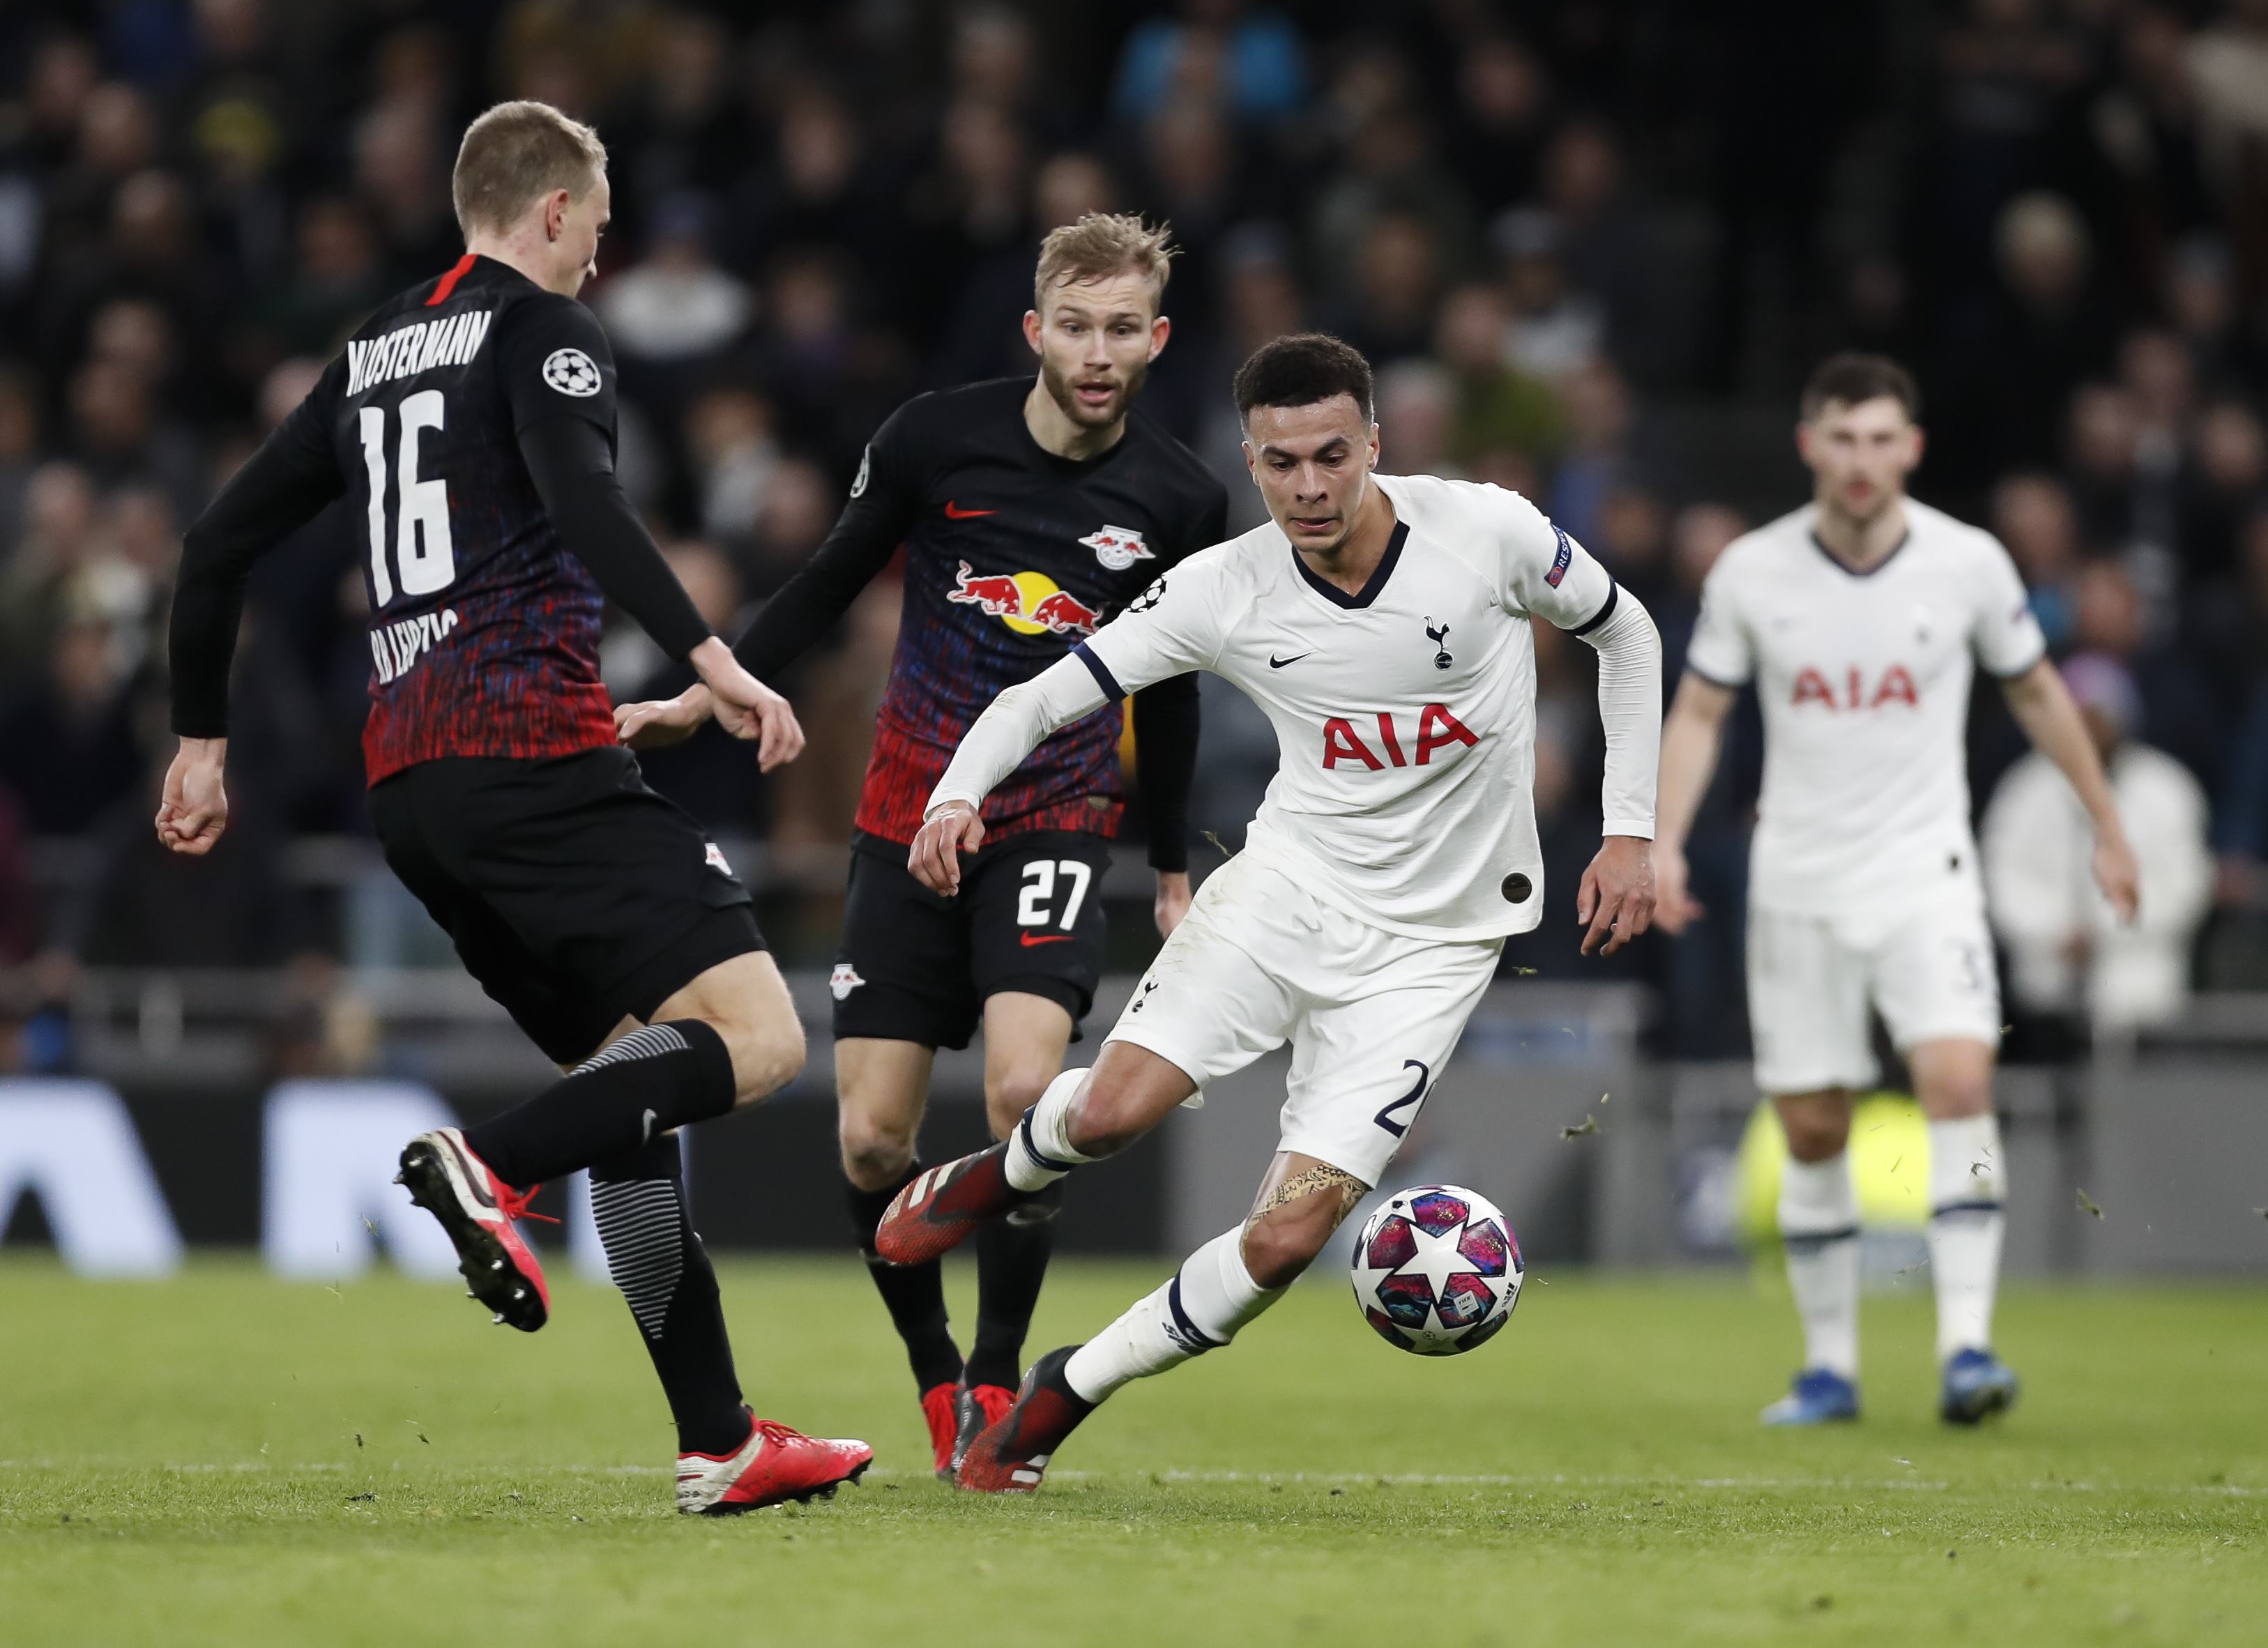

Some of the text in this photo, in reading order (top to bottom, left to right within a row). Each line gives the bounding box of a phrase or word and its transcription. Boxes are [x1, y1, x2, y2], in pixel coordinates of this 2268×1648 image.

[359, 389, 455, 608] 16
[1790, 664, 1919, 712] AIA
[1322, 703, 1480, 771] AIA
[1017, 860, 1091, 931] 27
